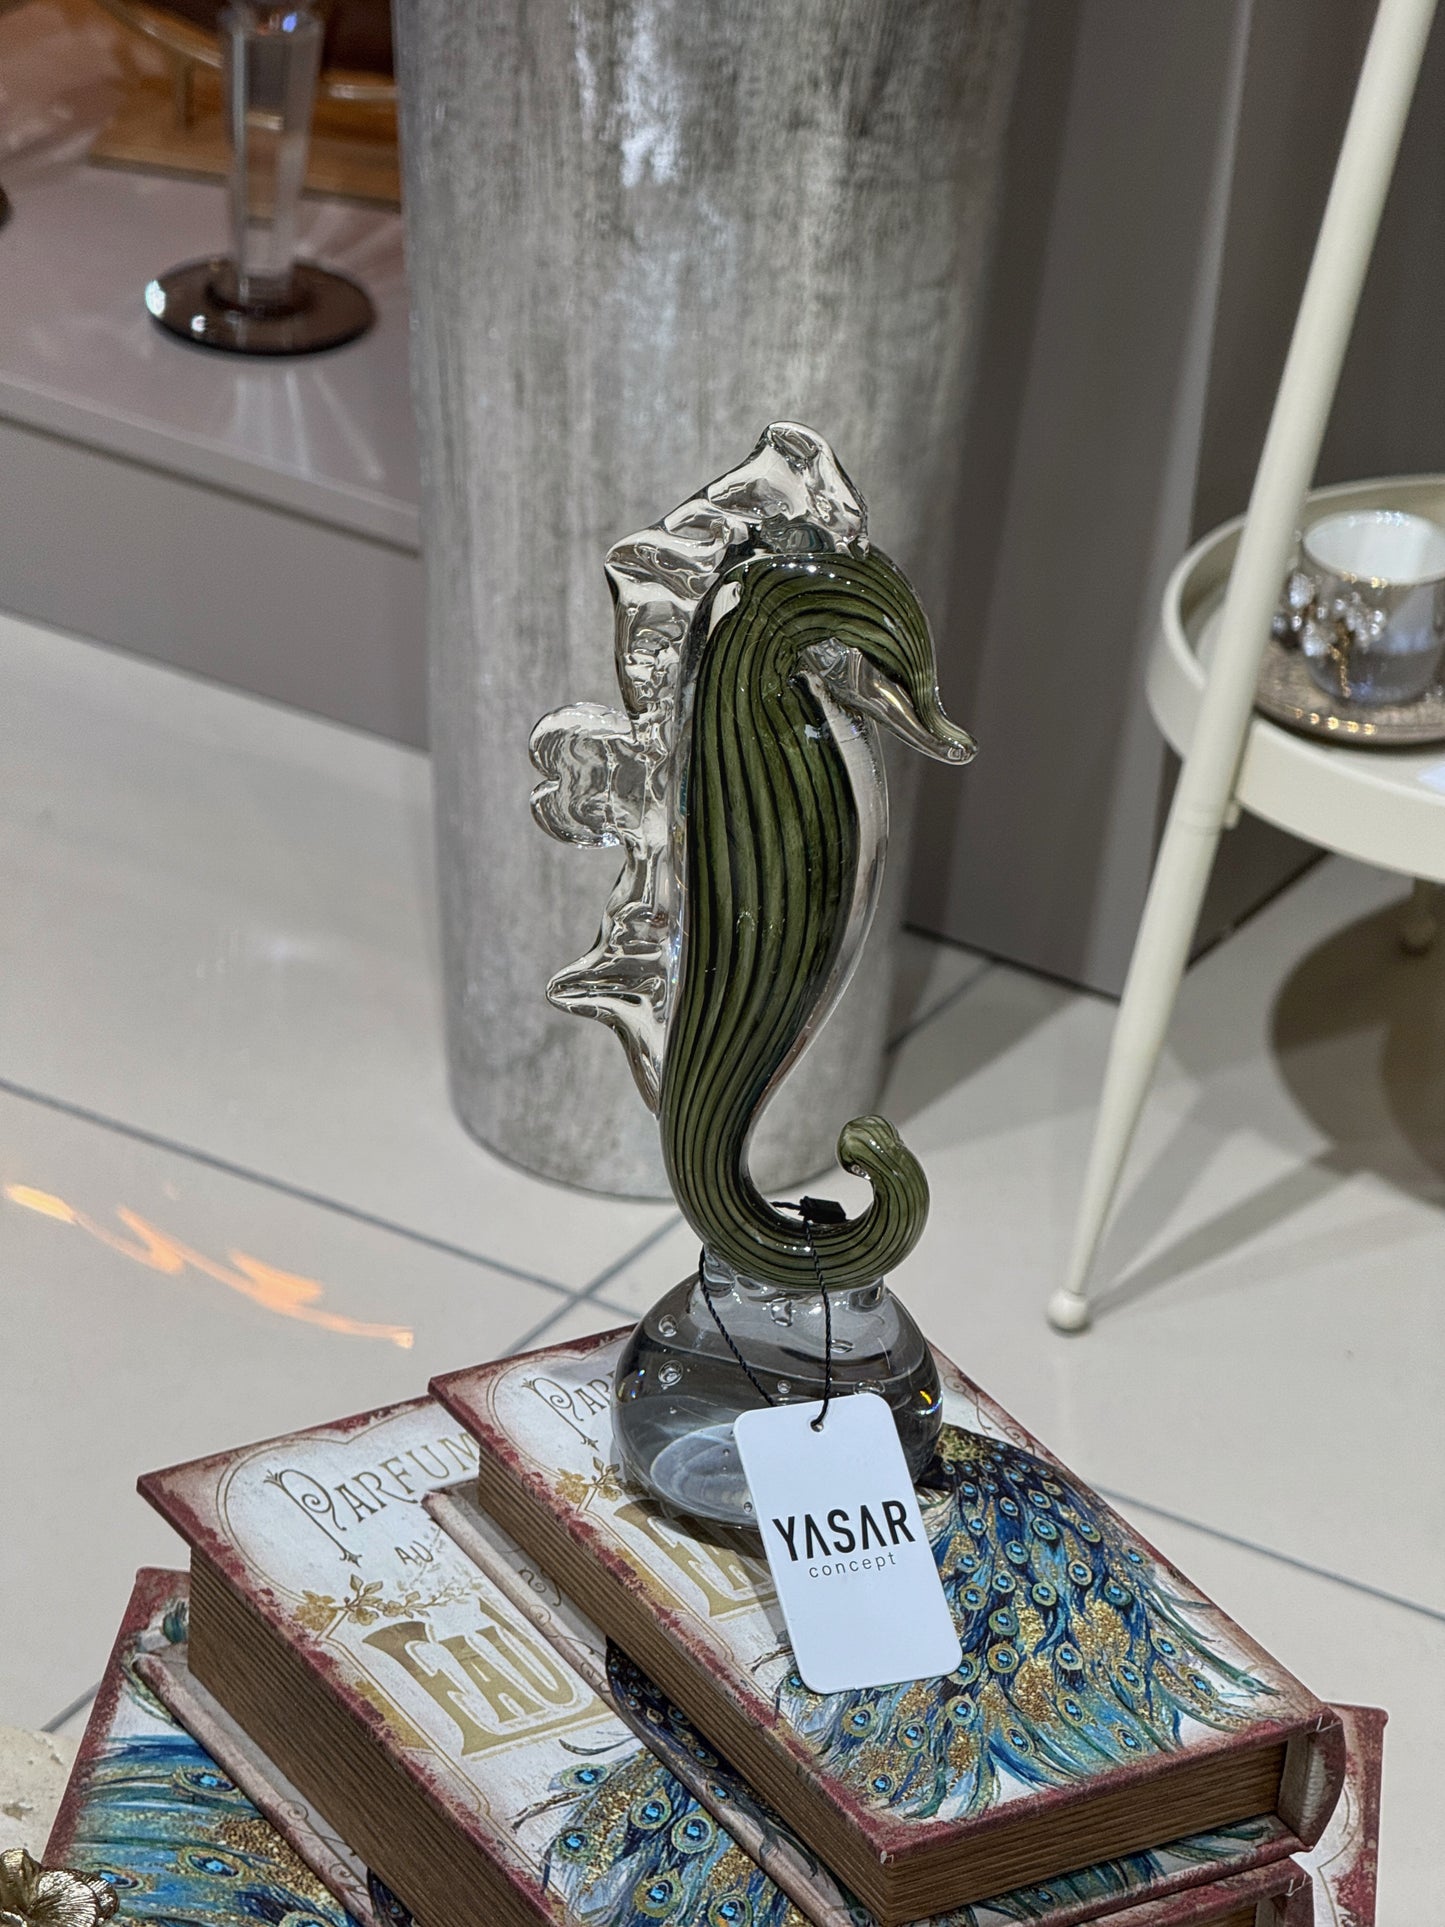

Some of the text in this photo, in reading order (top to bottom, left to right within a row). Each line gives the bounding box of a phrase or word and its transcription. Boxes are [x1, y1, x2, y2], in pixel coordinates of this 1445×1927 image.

[772, 1500, 916, 1562] YASAR
[808, 1551, 896, 1578] concept
[362, 1598, 612, 1757] EAU
